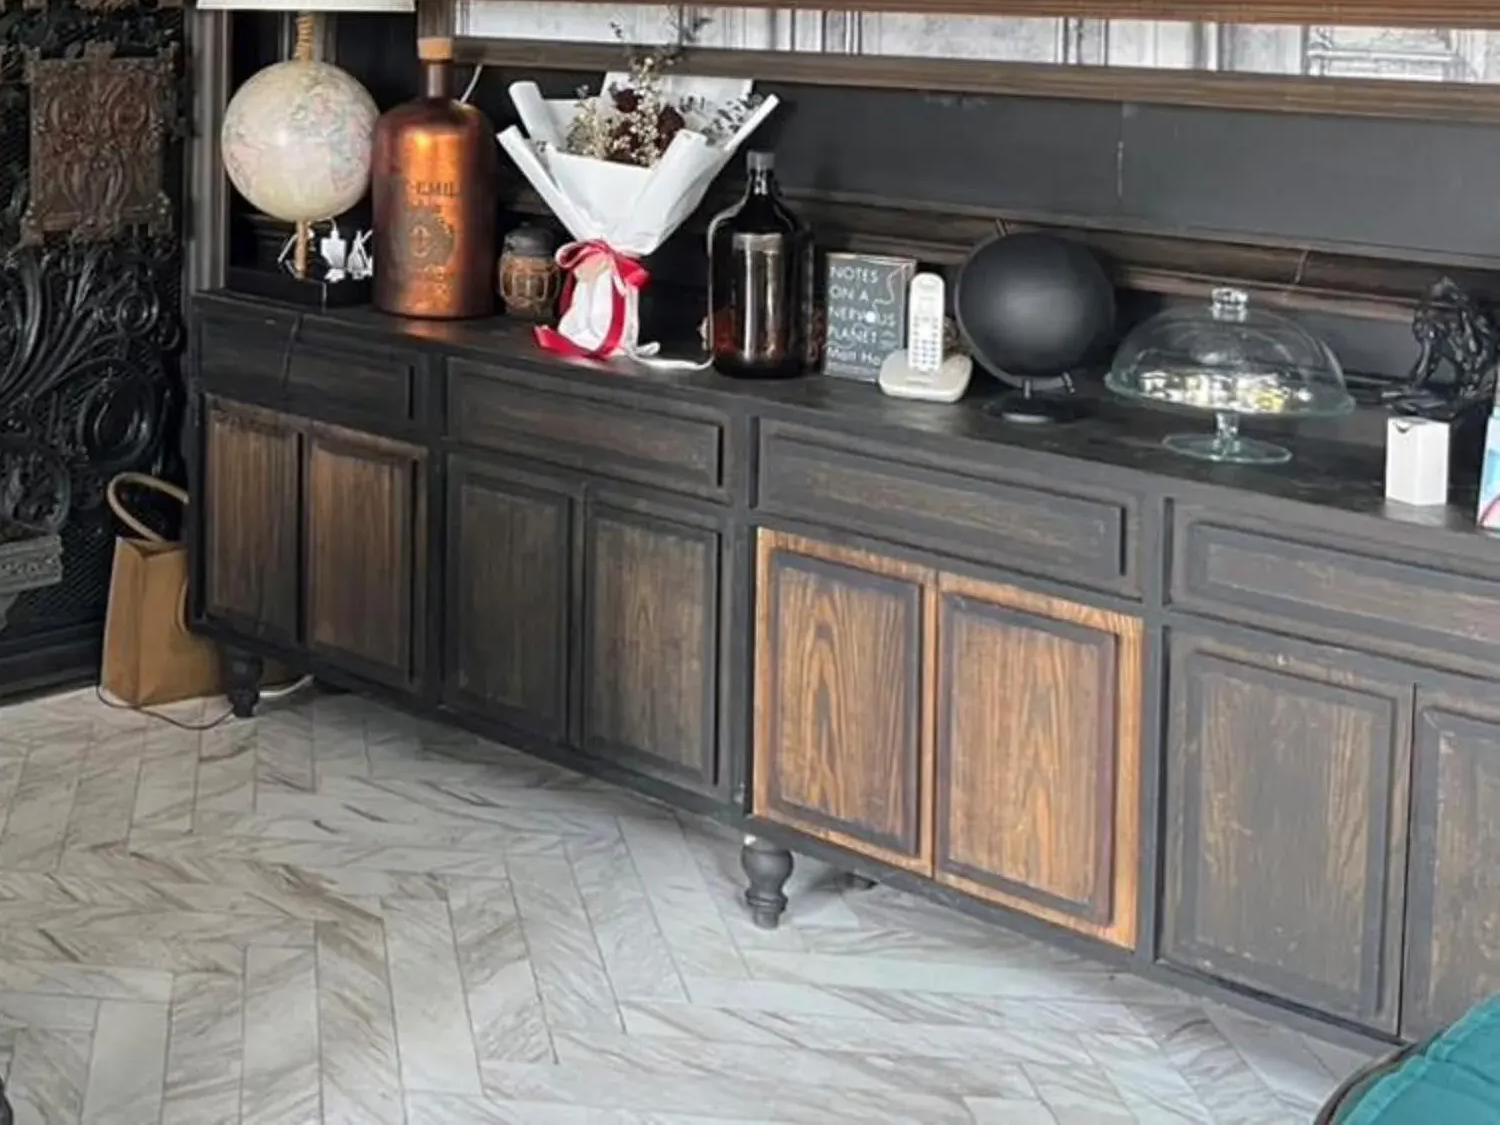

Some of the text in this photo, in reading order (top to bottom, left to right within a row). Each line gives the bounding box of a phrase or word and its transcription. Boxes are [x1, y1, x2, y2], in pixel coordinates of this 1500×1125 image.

[829, 265, 880, 285] NOTES
[828, 283, 869, 302] ON A
